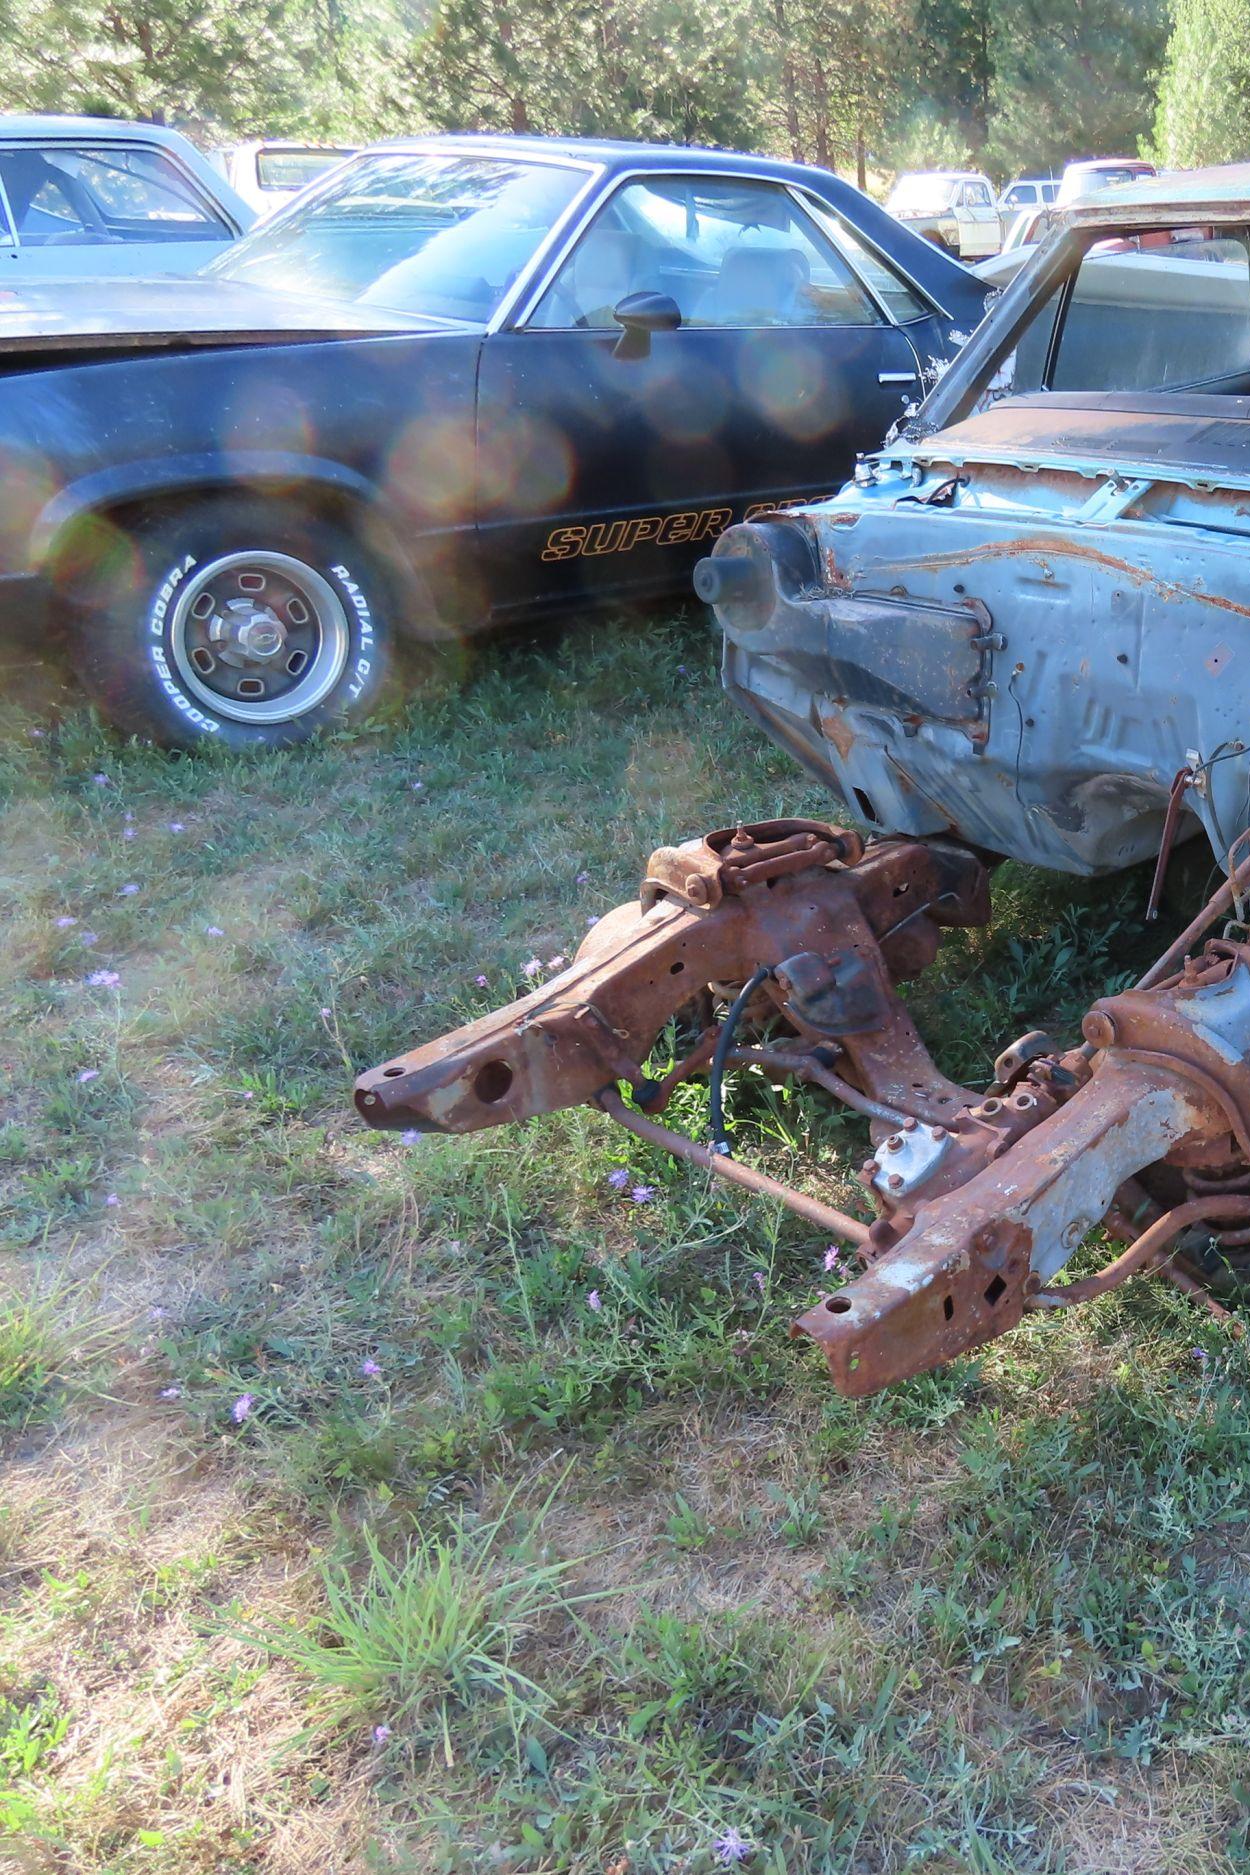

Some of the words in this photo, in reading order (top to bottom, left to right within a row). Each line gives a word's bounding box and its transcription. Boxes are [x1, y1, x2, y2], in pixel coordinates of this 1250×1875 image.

[151, 554, 197, 636] COBRA
[330, 564, 374, 651] RADIAL
[151, 646, 220, 732] COOPER
[349, 658, 371, 698] G/T
